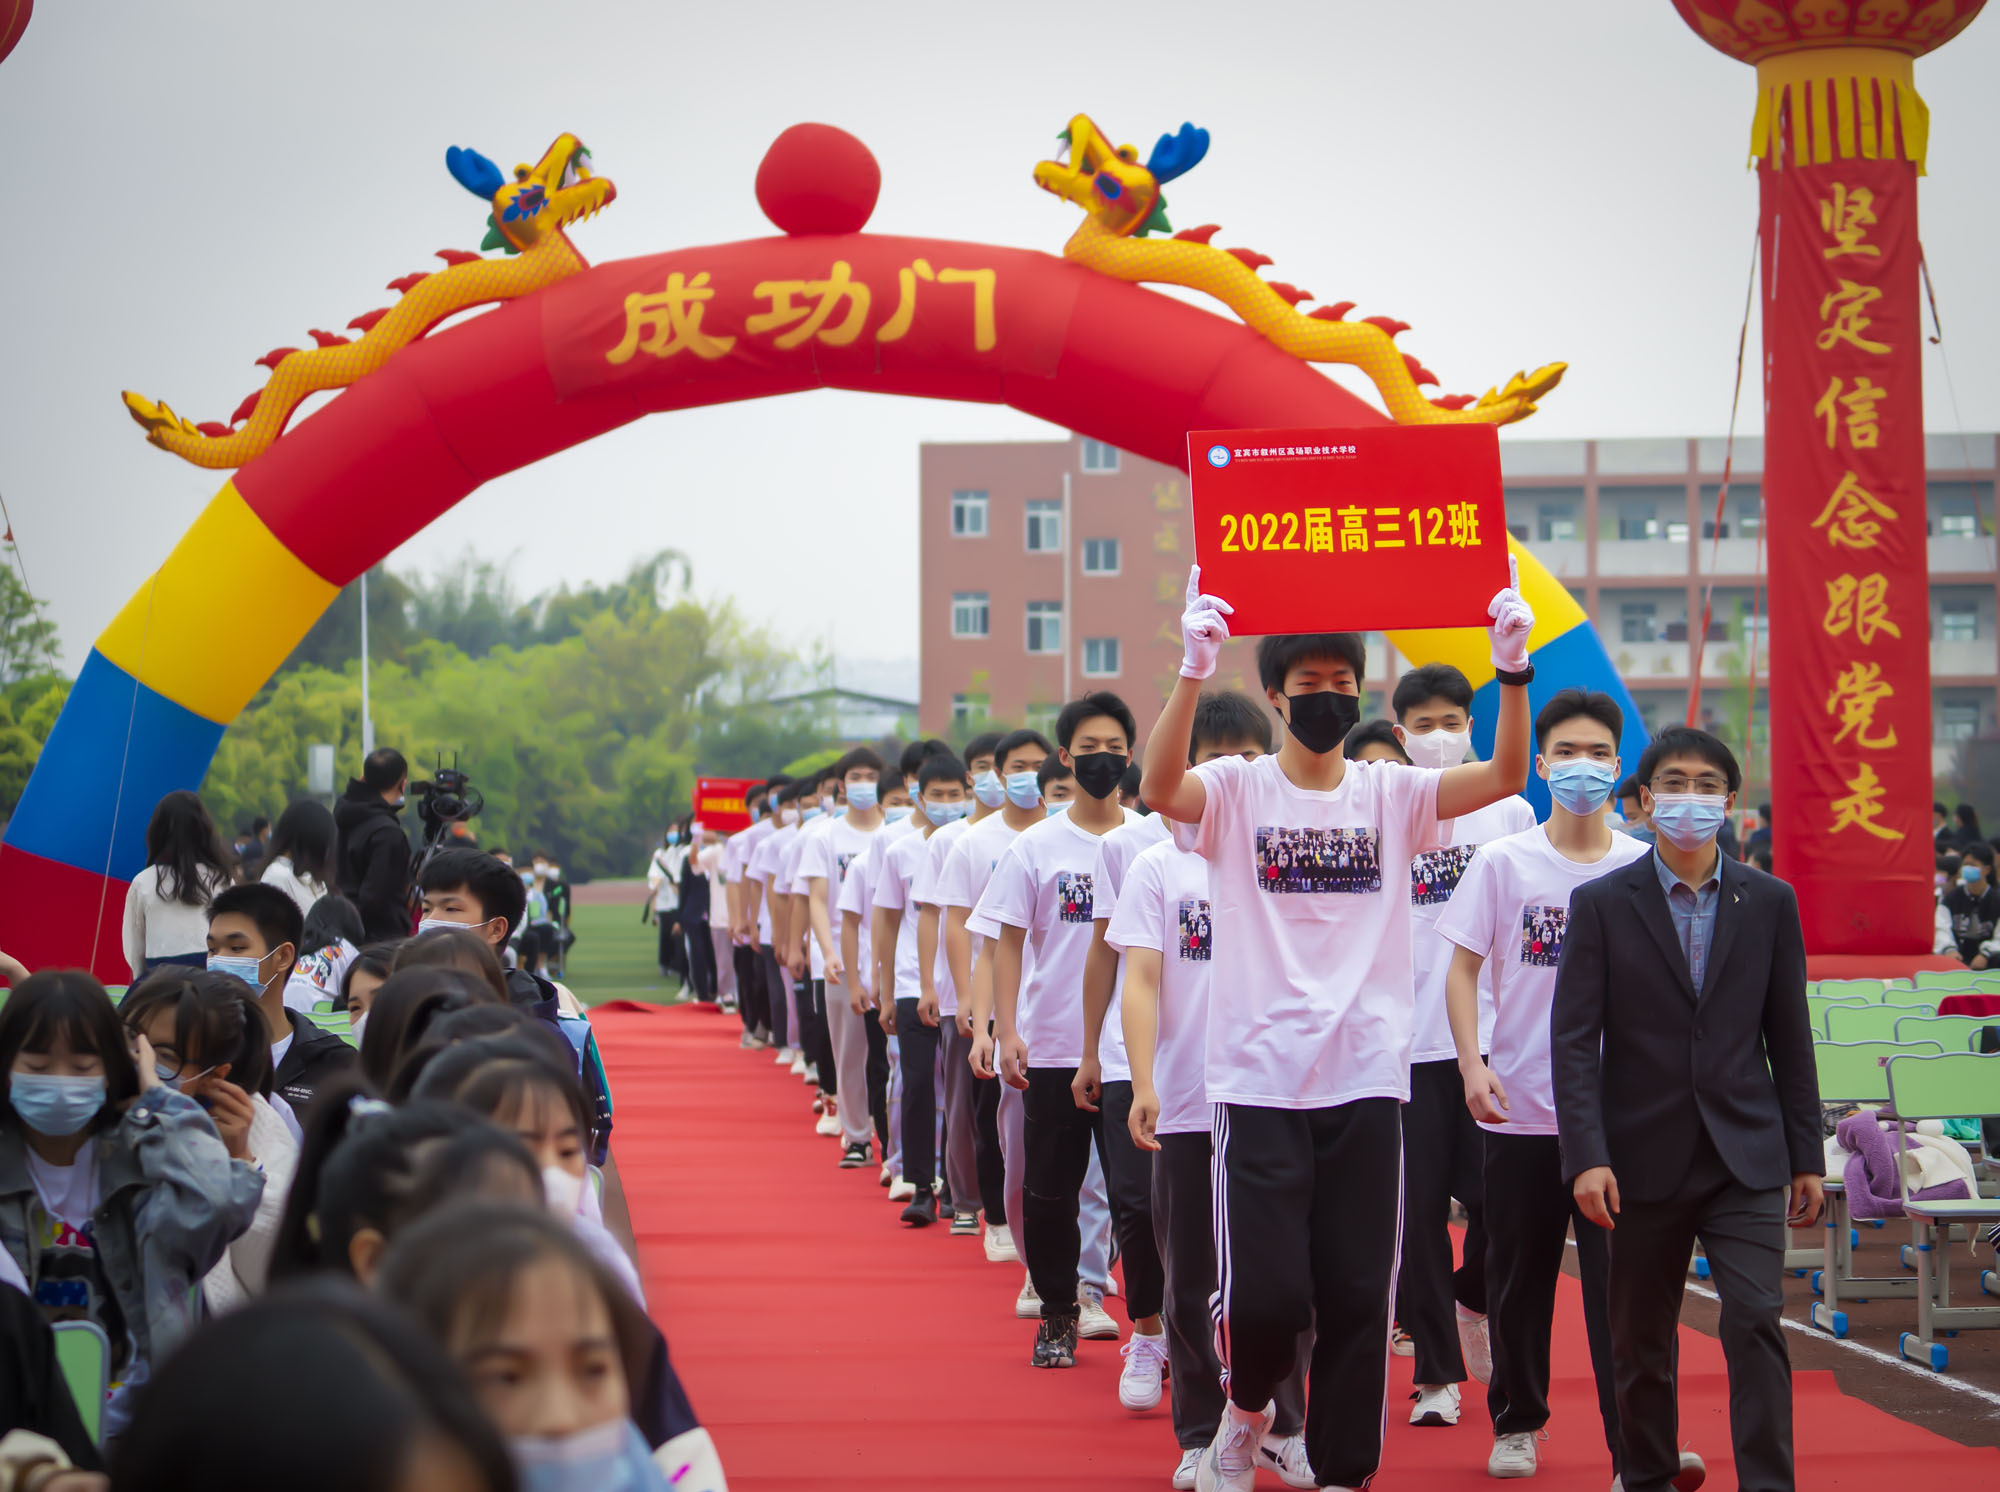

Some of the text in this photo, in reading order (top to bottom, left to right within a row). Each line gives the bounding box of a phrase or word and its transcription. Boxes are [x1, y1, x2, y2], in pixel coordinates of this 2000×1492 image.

[605, 258, 997, 364] 成功门
[1233, 445, 1357, 458] 宜宾市叙州区高场职业技术学校
[1219, 501, 1482, 553] 2022届高三12班
[1811, 182, 1905, 841] 坚定信念跟党走
